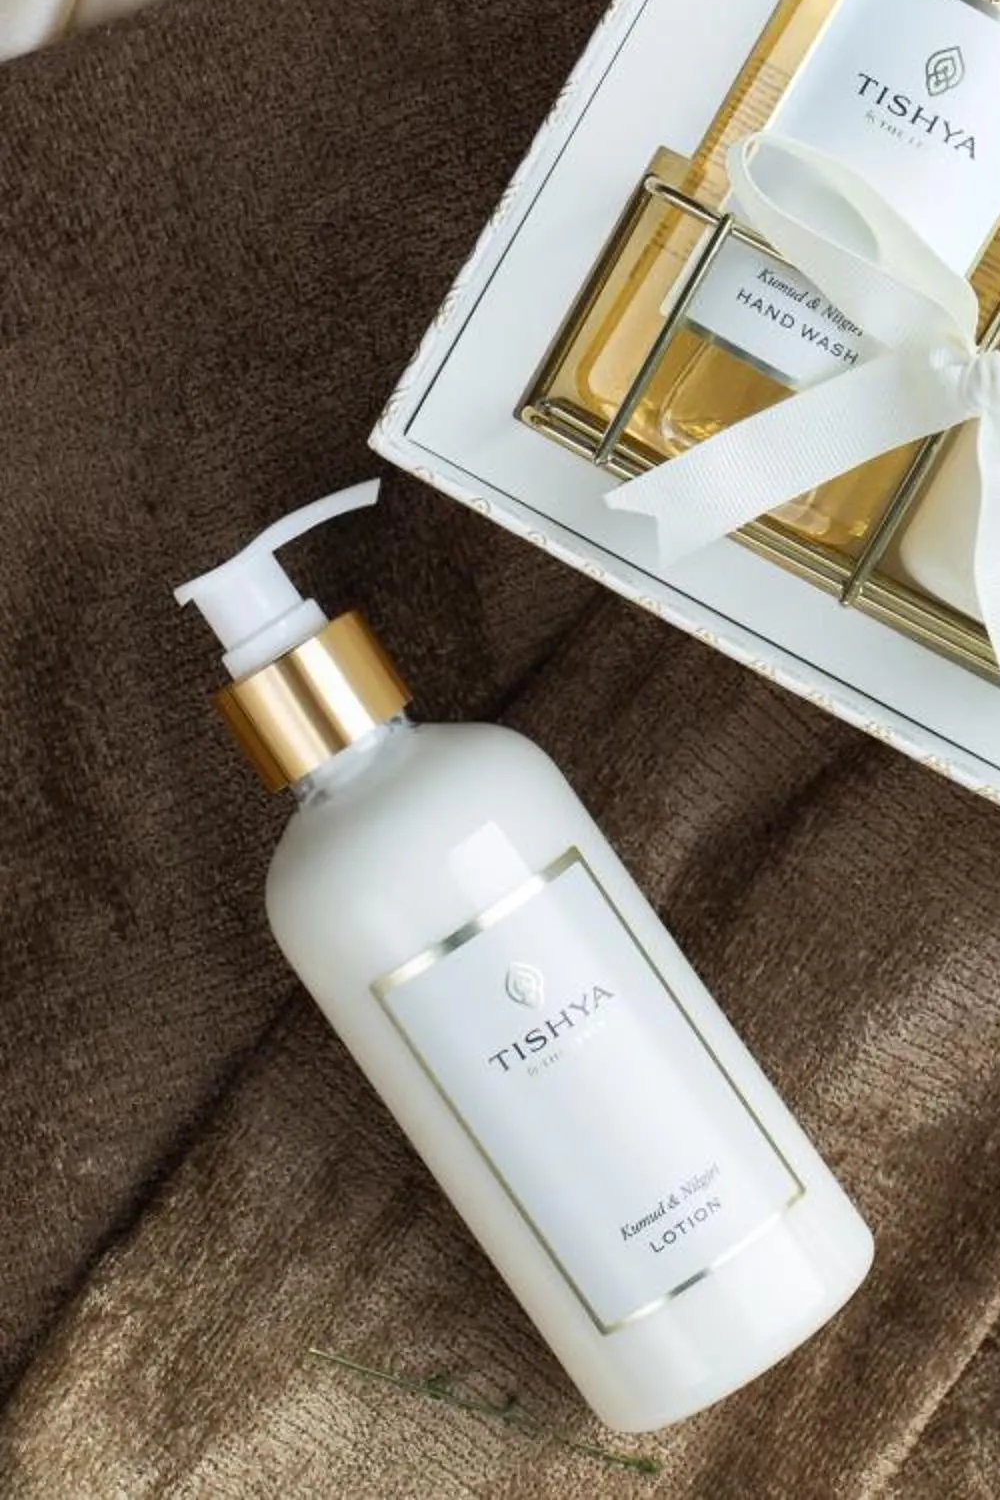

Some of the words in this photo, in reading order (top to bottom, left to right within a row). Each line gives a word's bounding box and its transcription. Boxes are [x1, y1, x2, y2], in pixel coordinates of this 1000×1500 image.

[858, 73, 975, 160] TISHYA
[757, 268, 809, 303] Kumud
[805, 297, 821, 311] &
[736, 287, 796, 329] HAND
[800, 323, 859, 365] WASH
[488, 985, 615, 1072] TISHYA
[620, 1201, 667, 1241] Kumud
[667, 1193, 681, 1209] &
[648, 1197, 721, 1253] LOTION
